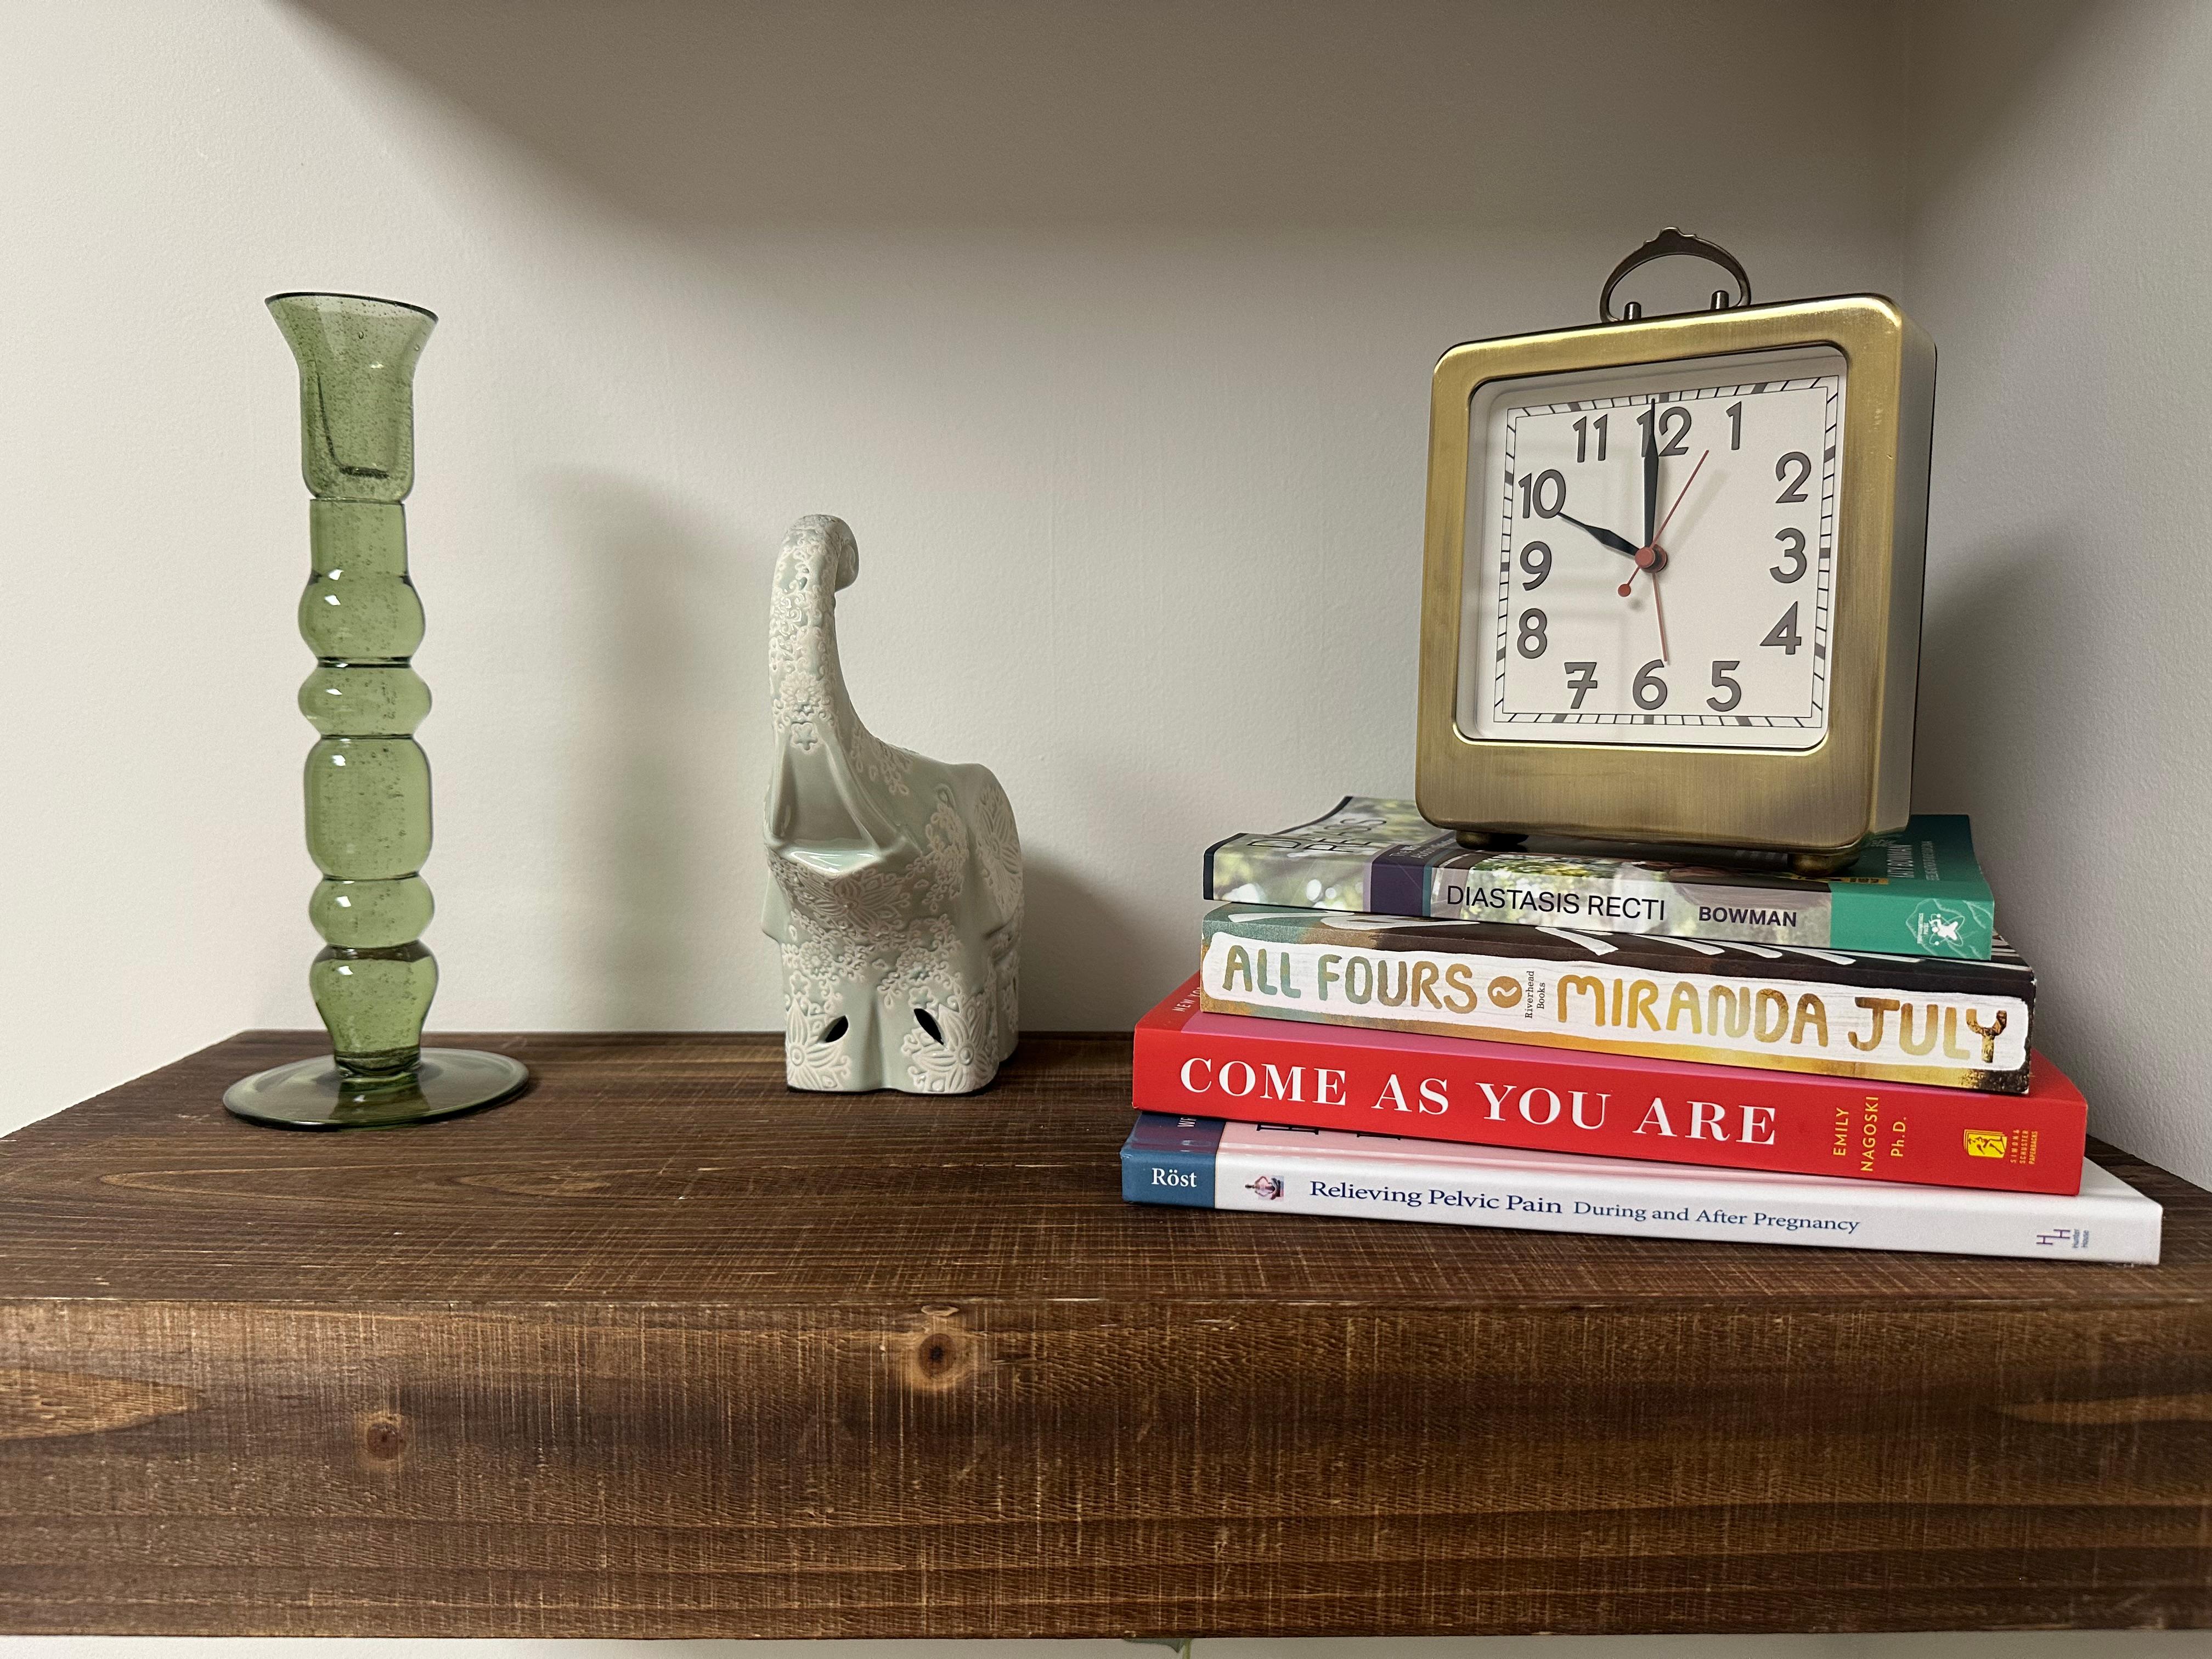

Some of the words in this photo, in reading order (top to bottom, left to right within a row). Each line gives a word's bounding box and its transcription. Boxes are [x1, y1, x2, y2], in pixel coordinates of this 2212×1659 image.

[1572, 414, 1607, 463] 11
[1637, 406, 1692, 458] 12
[1725, 401, 1742, 450] 1
[1518, 469, 1566, 518] 10
[1775, 452, 1812, 504] 2
[1520, 540, 1552, 591] 9
[1769, 528, 1807, 584] 3
[1516, 608, 1548, 659] 8
[1759, 601, 1802, 655] 4
[1564, 661, 1598, 709] 7
[1632, 659, 1668, 710] 6
[1706, 660, 1742, 712] 5
[1447, 884, 1580, 915] DIASTASIS
[1588, 896, 1664, 921] RECTI
[1699, 906, 1797, 927] BOWMAN
[1222, 945, 1301, 999] ALL
[1318, 953, 1478, 1014] FOURS
[1525, 970, 1535, 1019] Riverhead
[1537, 982, 1546, 1010] Books
[1172, 998, 1195, 1012] NEW
[1557, 974, 1829, 1047] MIRANDA
[1847, 996, 2007, 1063] JULY
[1181, 1057, 1347, 1107] COME
[1371, 1073, 1449, 1115] AS
[1475, 1082, 1611, 1130] YOU
[1632, 1097, 1776, 1146] ARE
[1833, 1107, 1849, 1156] EMILY
[1860, 1096, 1880, 1172] NAGOSKI
[1891, 1116, 1907, 1158] Ph.D.
[2010, 1136, 2019, 1164] SIMON
[2019, 1130, 2029, 1164] SCHUSTER
[2028, 1131, 2038, 1165] PAPERBACKS
[1152, 1167, 1197, 1188] Röst
[1310, 1181, 1423, 1207] Relieving
[1428, 1189, 1499, 1210] Pelvic
[1506, 1194, 1562, 1214] Pain
[1573, 1200, 1646, 1222] During
[1652, 1207, 1689, 1221] and
[1695, 1209, 1748, 1225] After
[1753, 1212, 1860, 1234] Pregnancy
